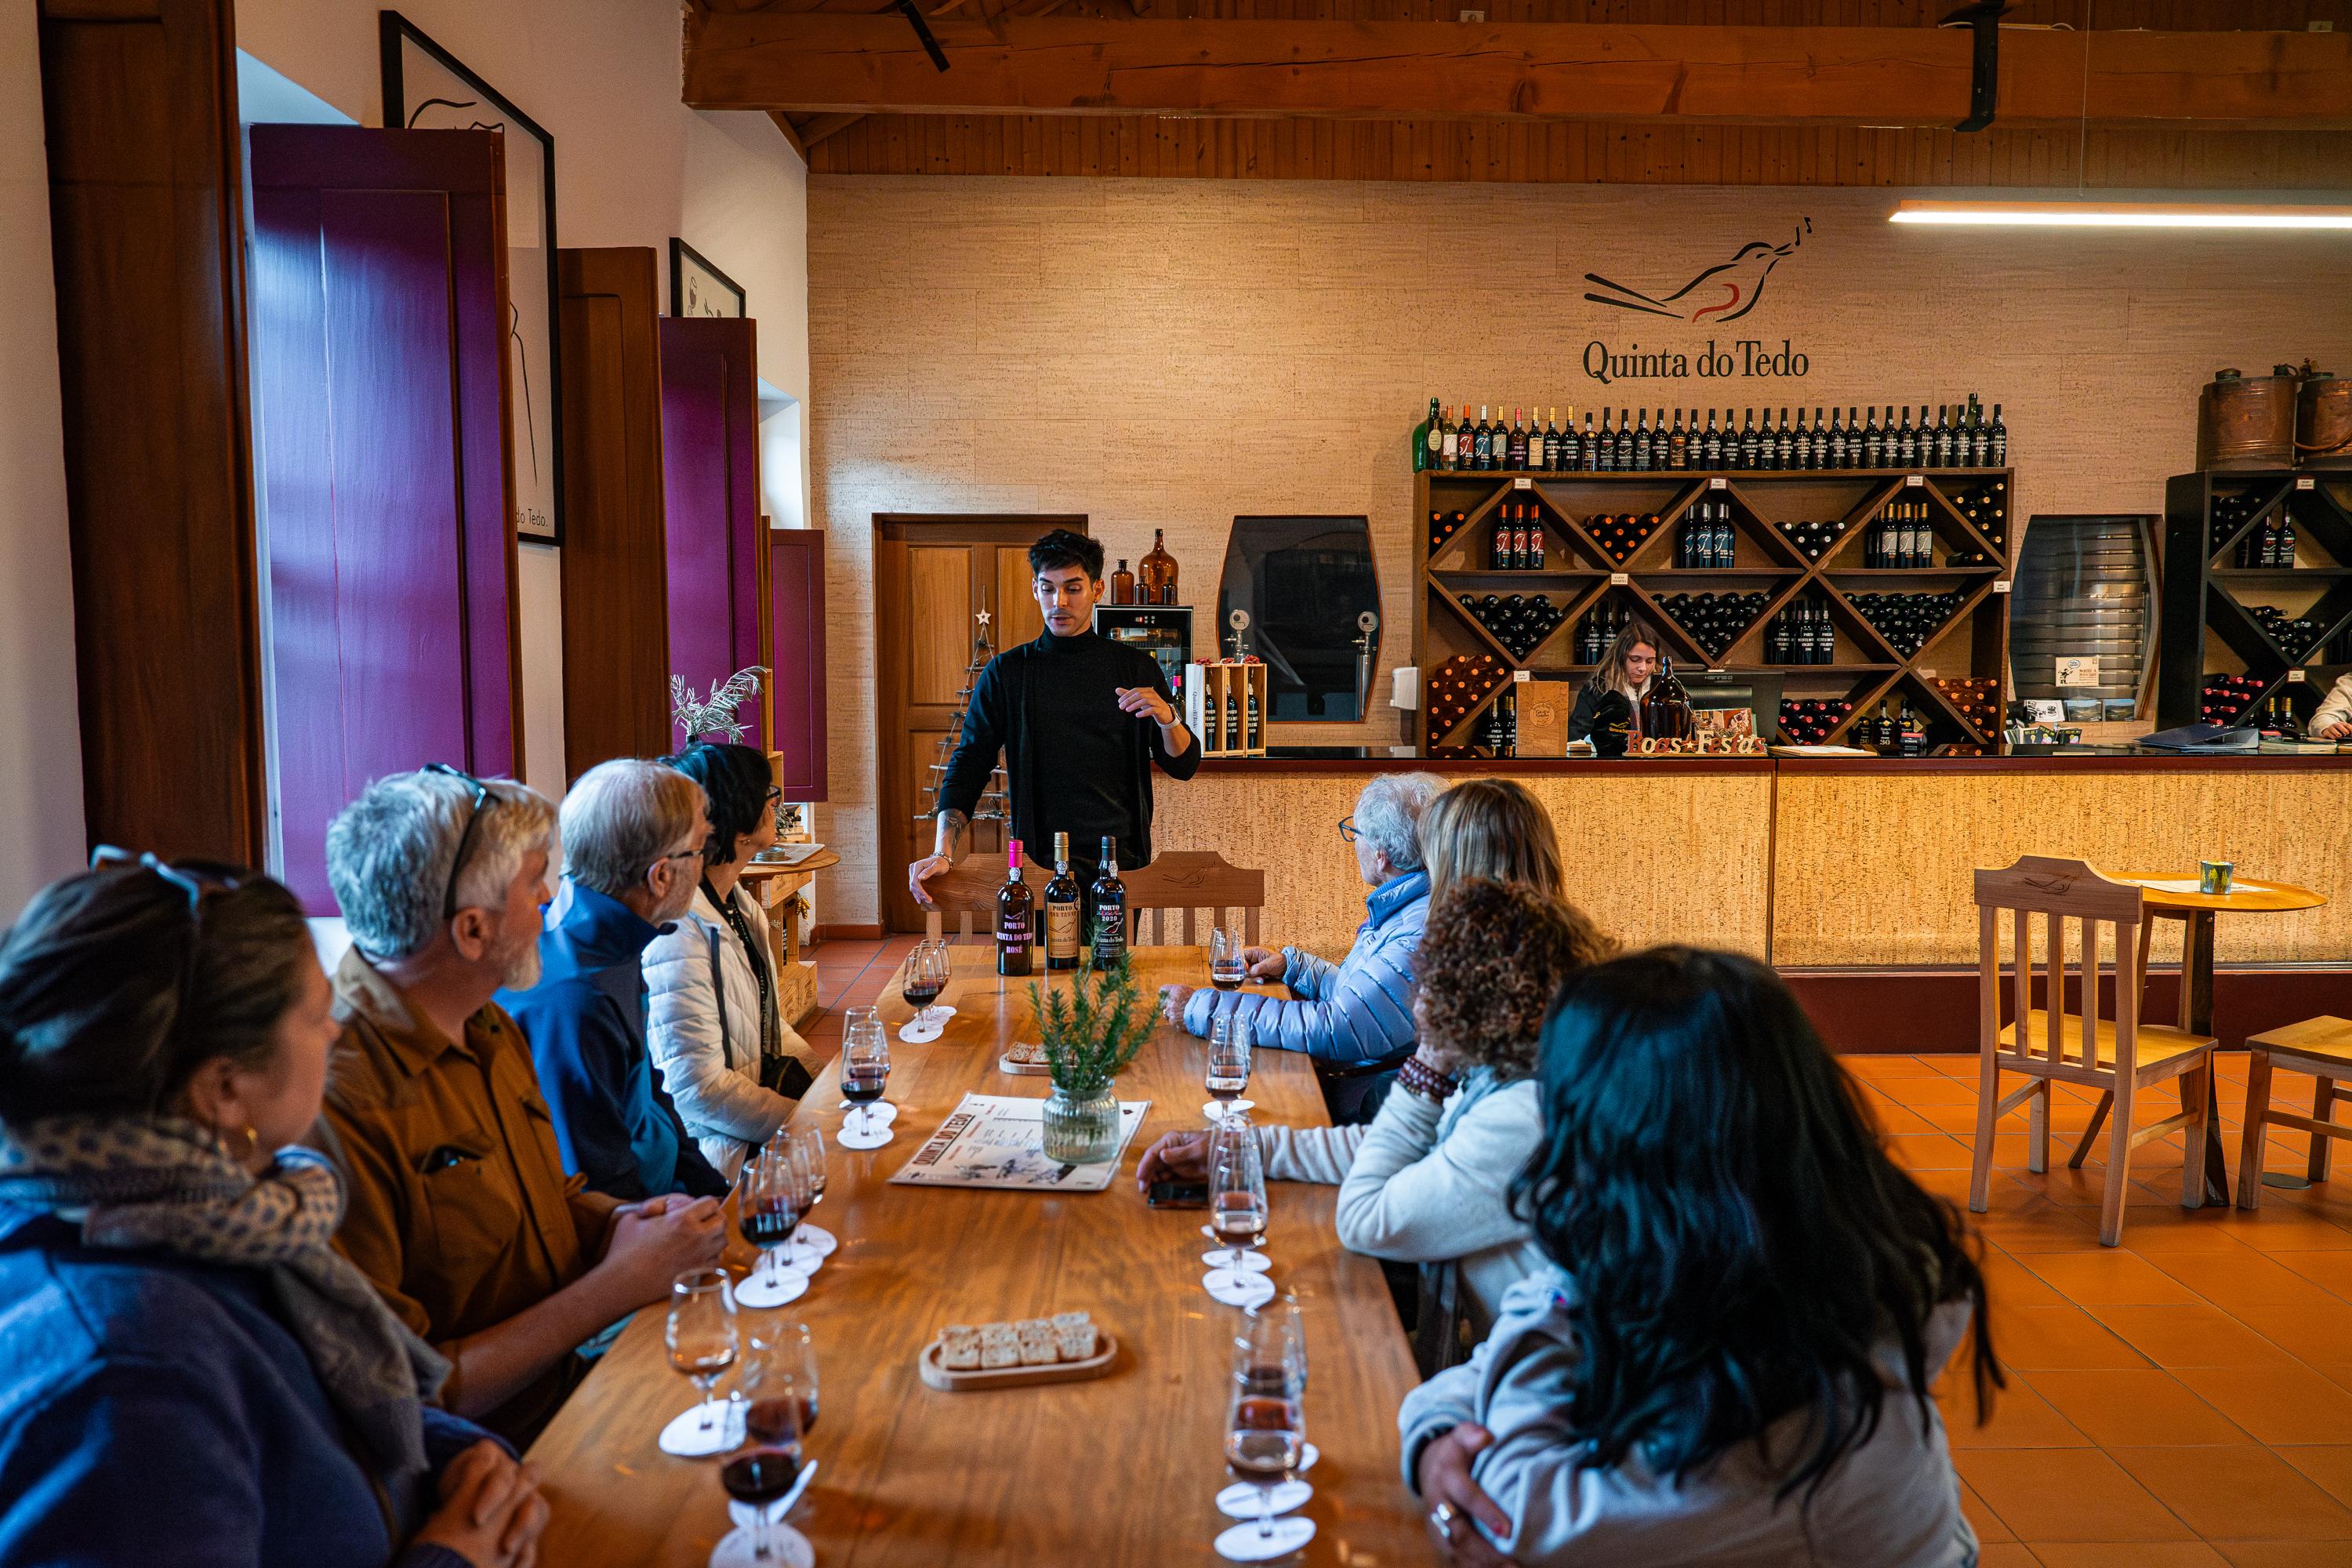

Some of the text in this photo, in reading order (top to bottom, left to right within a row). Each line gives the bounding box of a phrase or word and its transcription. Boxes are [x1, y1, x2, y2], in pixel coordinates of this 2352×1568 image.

[1583, 338, 1809, 384] Quinta do Tedo
[528, 508, 548, 527] Tedo.
[1626, 730, 1766, 754] Boas Festas
[1004, 921, 1025, 930] PORTO
[1006, 944, 1023, 953] ROSÉ
[912, 1113, 972, 1165] QUINTA DO TEDO
